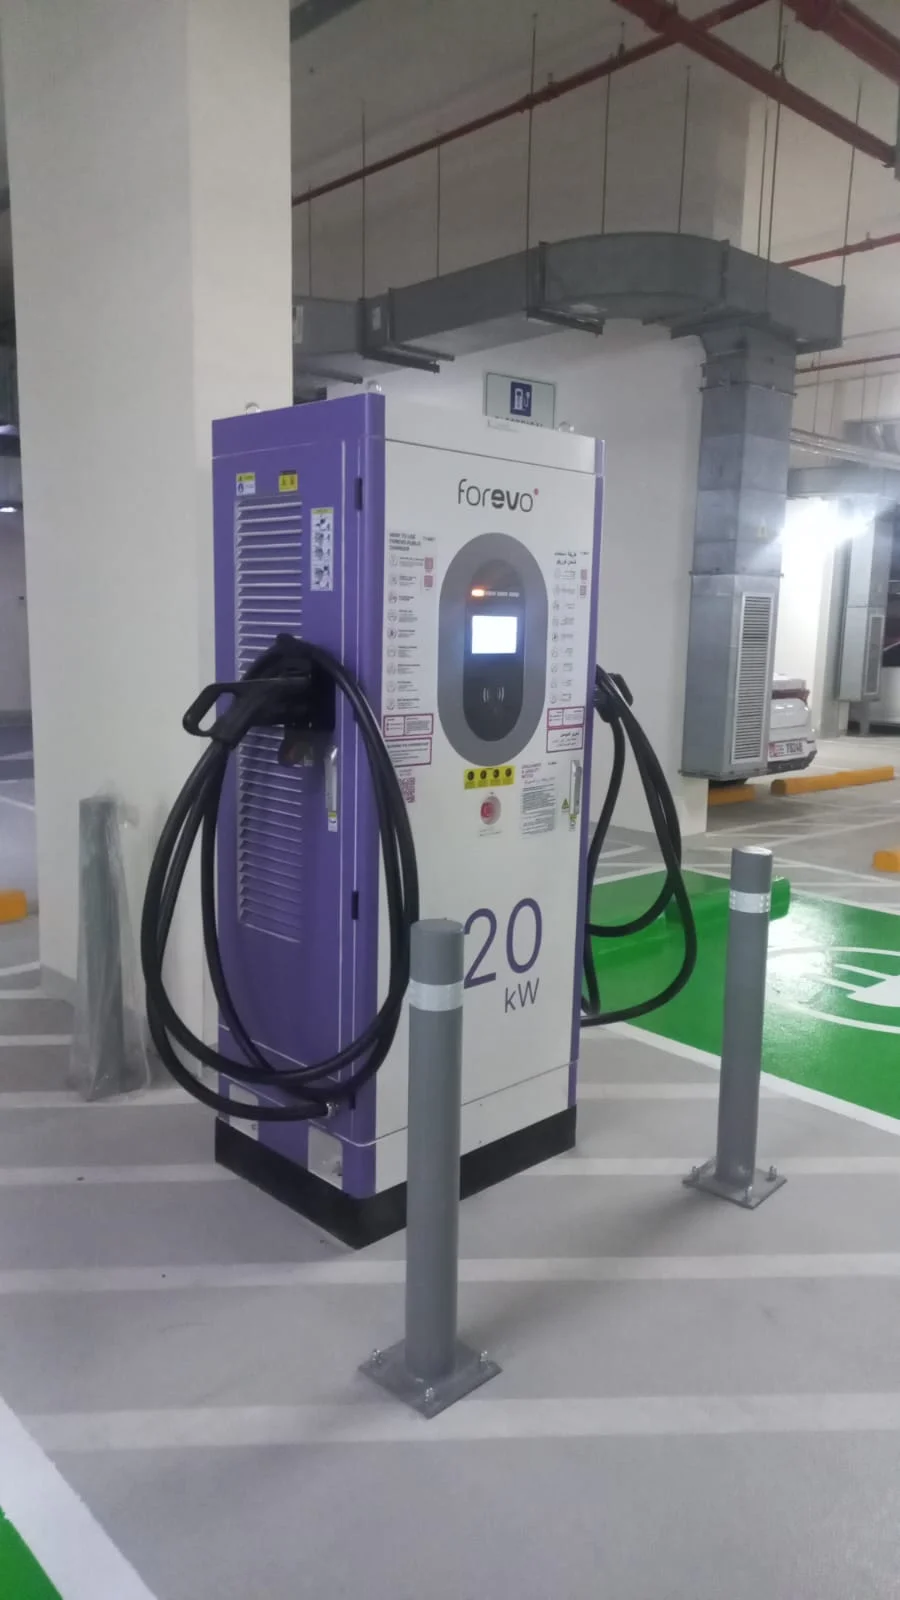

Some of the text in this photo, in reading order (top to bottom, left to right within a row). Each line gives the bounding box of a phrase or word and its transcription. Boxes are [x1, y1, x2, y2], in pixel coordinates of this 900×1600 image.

[458, 478, 534, 512] forevo
[456, 897, 542, 989] 20
[504, 977, 540, 1013] kW
